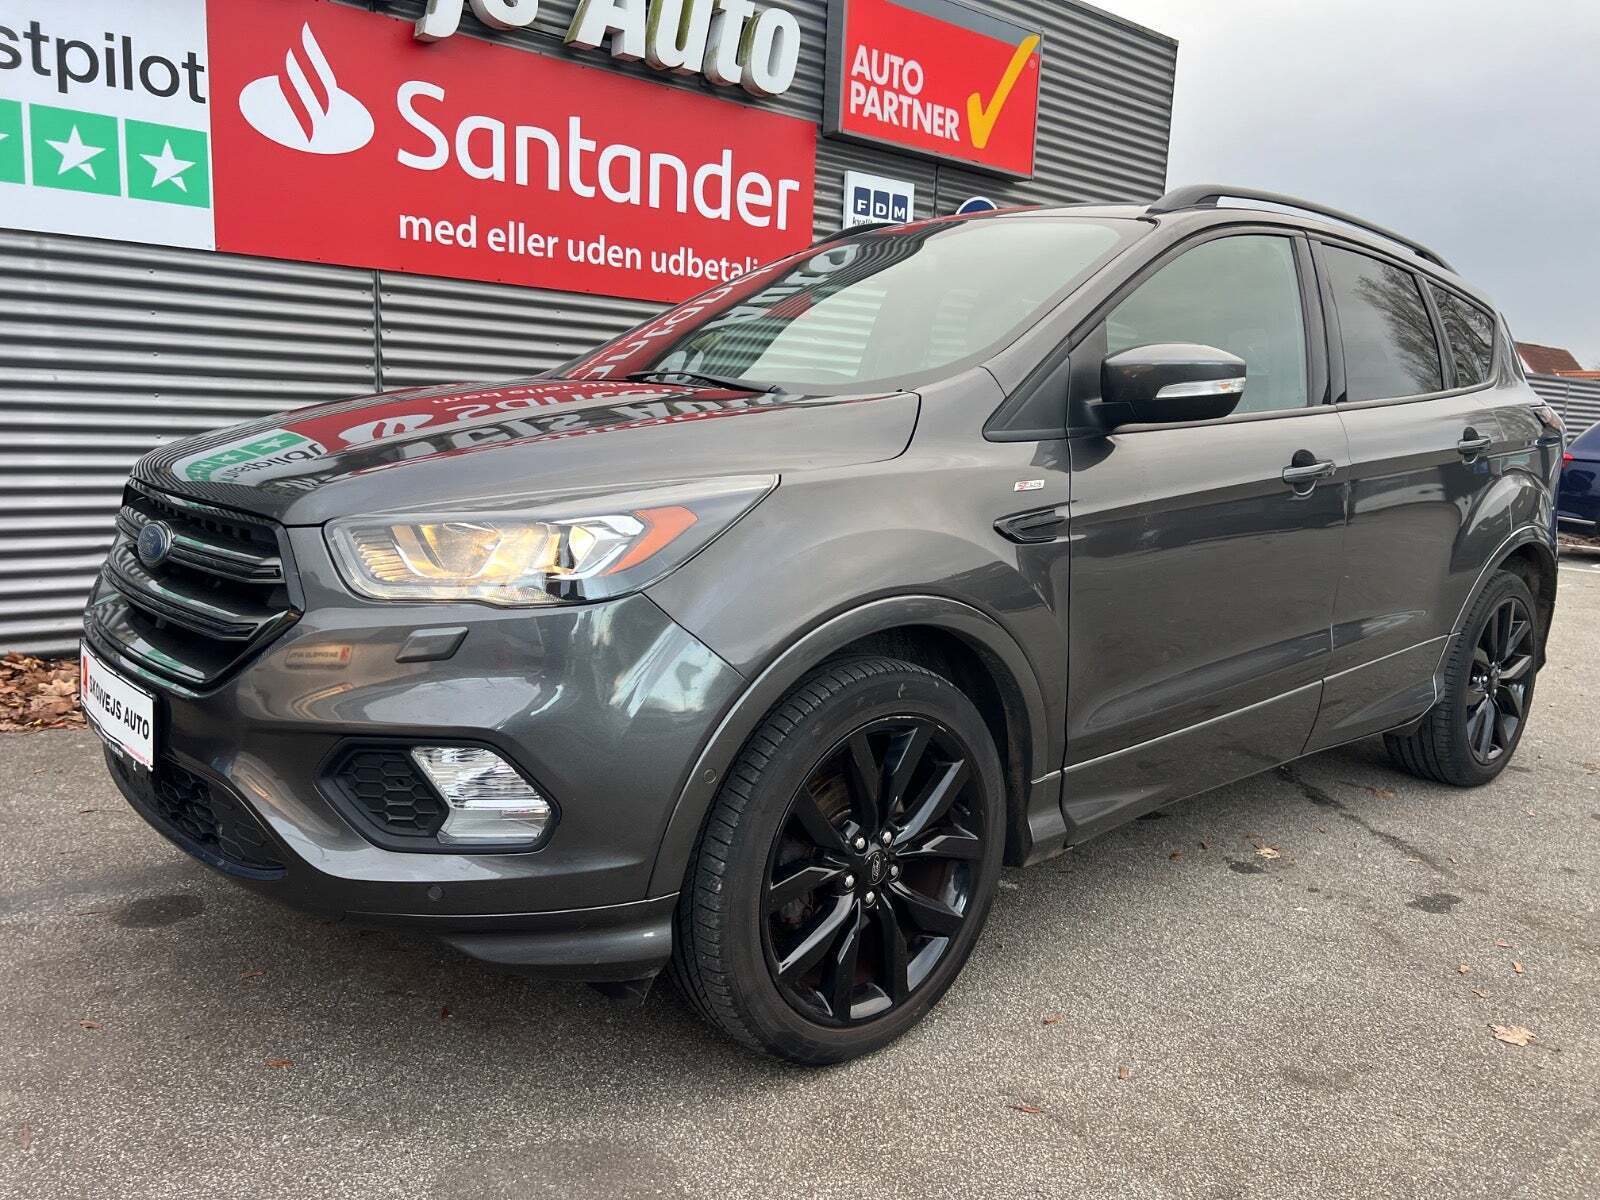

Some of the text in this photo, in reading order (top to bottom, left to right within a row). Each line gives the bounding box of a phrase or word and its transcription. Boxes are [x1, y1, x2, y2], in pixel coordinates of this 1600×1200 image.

[851, 44, 924, 95] AUTO
[850, 80, 960, 142] PARTNER
[397, 80, 800, 230] Santander
[856, 199, 906, 220] FDM
[400, 214, 477, 248] med
[487, 220, 559, 258] eller
[567, 234, 642, 270] uden
[124, 706, 150, 740] AUTO
